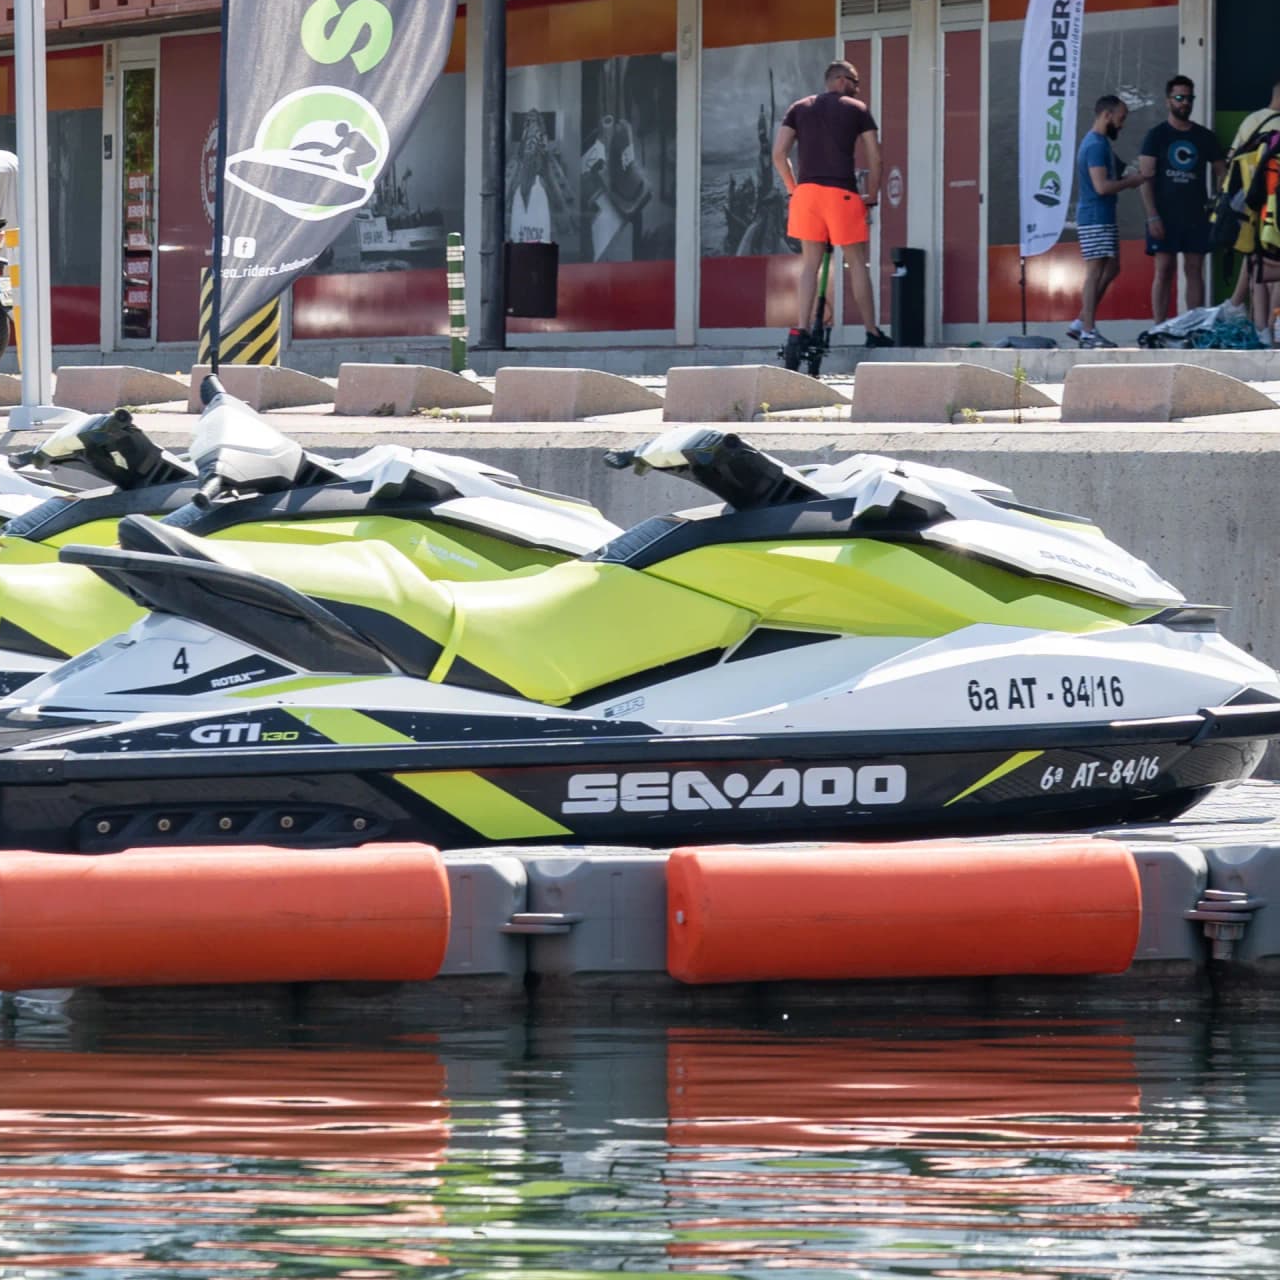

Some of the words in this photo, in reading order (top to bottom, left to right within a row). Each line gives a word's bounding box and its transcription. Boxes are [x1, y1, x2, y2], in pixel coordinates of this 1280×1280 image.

[172, 647, 190, 675] 4
[210, 671, 253, 688] ROTAX
[968, 679, 1000, 712] 6a
[1008, 676, 1038, 710] AT
